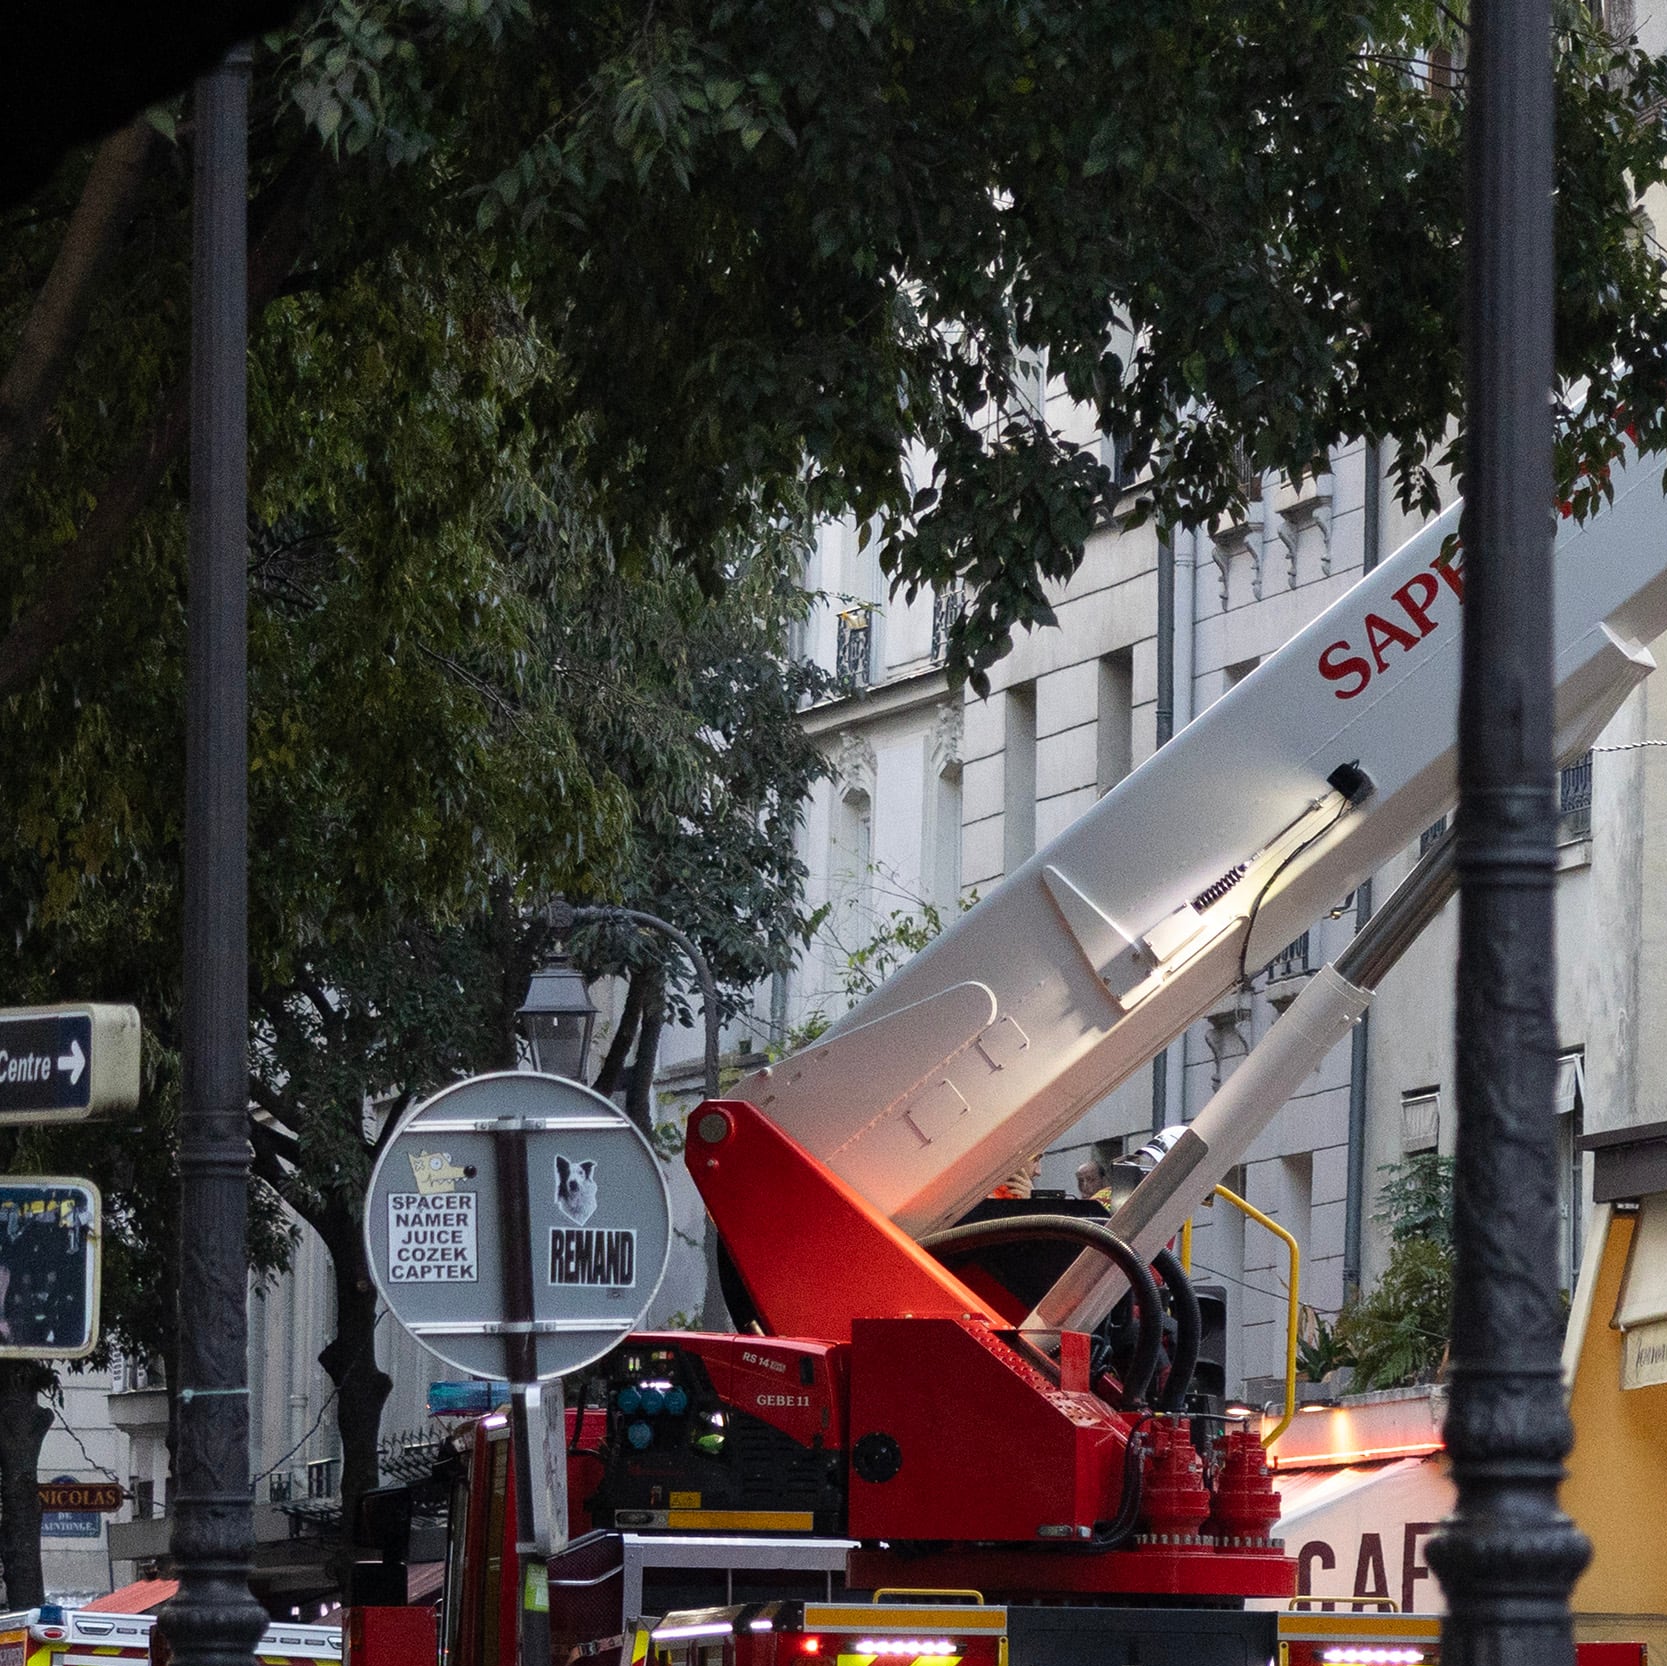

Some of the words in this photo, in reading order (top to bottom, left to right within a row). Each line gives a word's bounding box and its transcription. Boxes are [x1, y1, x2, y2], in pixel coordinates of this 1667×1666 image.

[0, 1049, 51, 1083] Centre
[392, 1195, 472, 1210] SPACER
[396, 1213, 468, 1227] NAMER
[402, 1230, 463, 1244] JUICE
[397, 1247, 467, 1262] COZEK
[550, 1229, 634, 1286] REMAND
[391, 1264, 474, 1279] CAPTEK
[743, 1352, 757, 1364] RS
[756, 1394, 795, 1406] GEBE
[797, 1396, 809, 1406] 11
[38, 1490, 116, 1505] NICOLAS
[41, 1521, 94, 1531] AINTONGE
[1297, 1522, 1440, 1613] CAF
